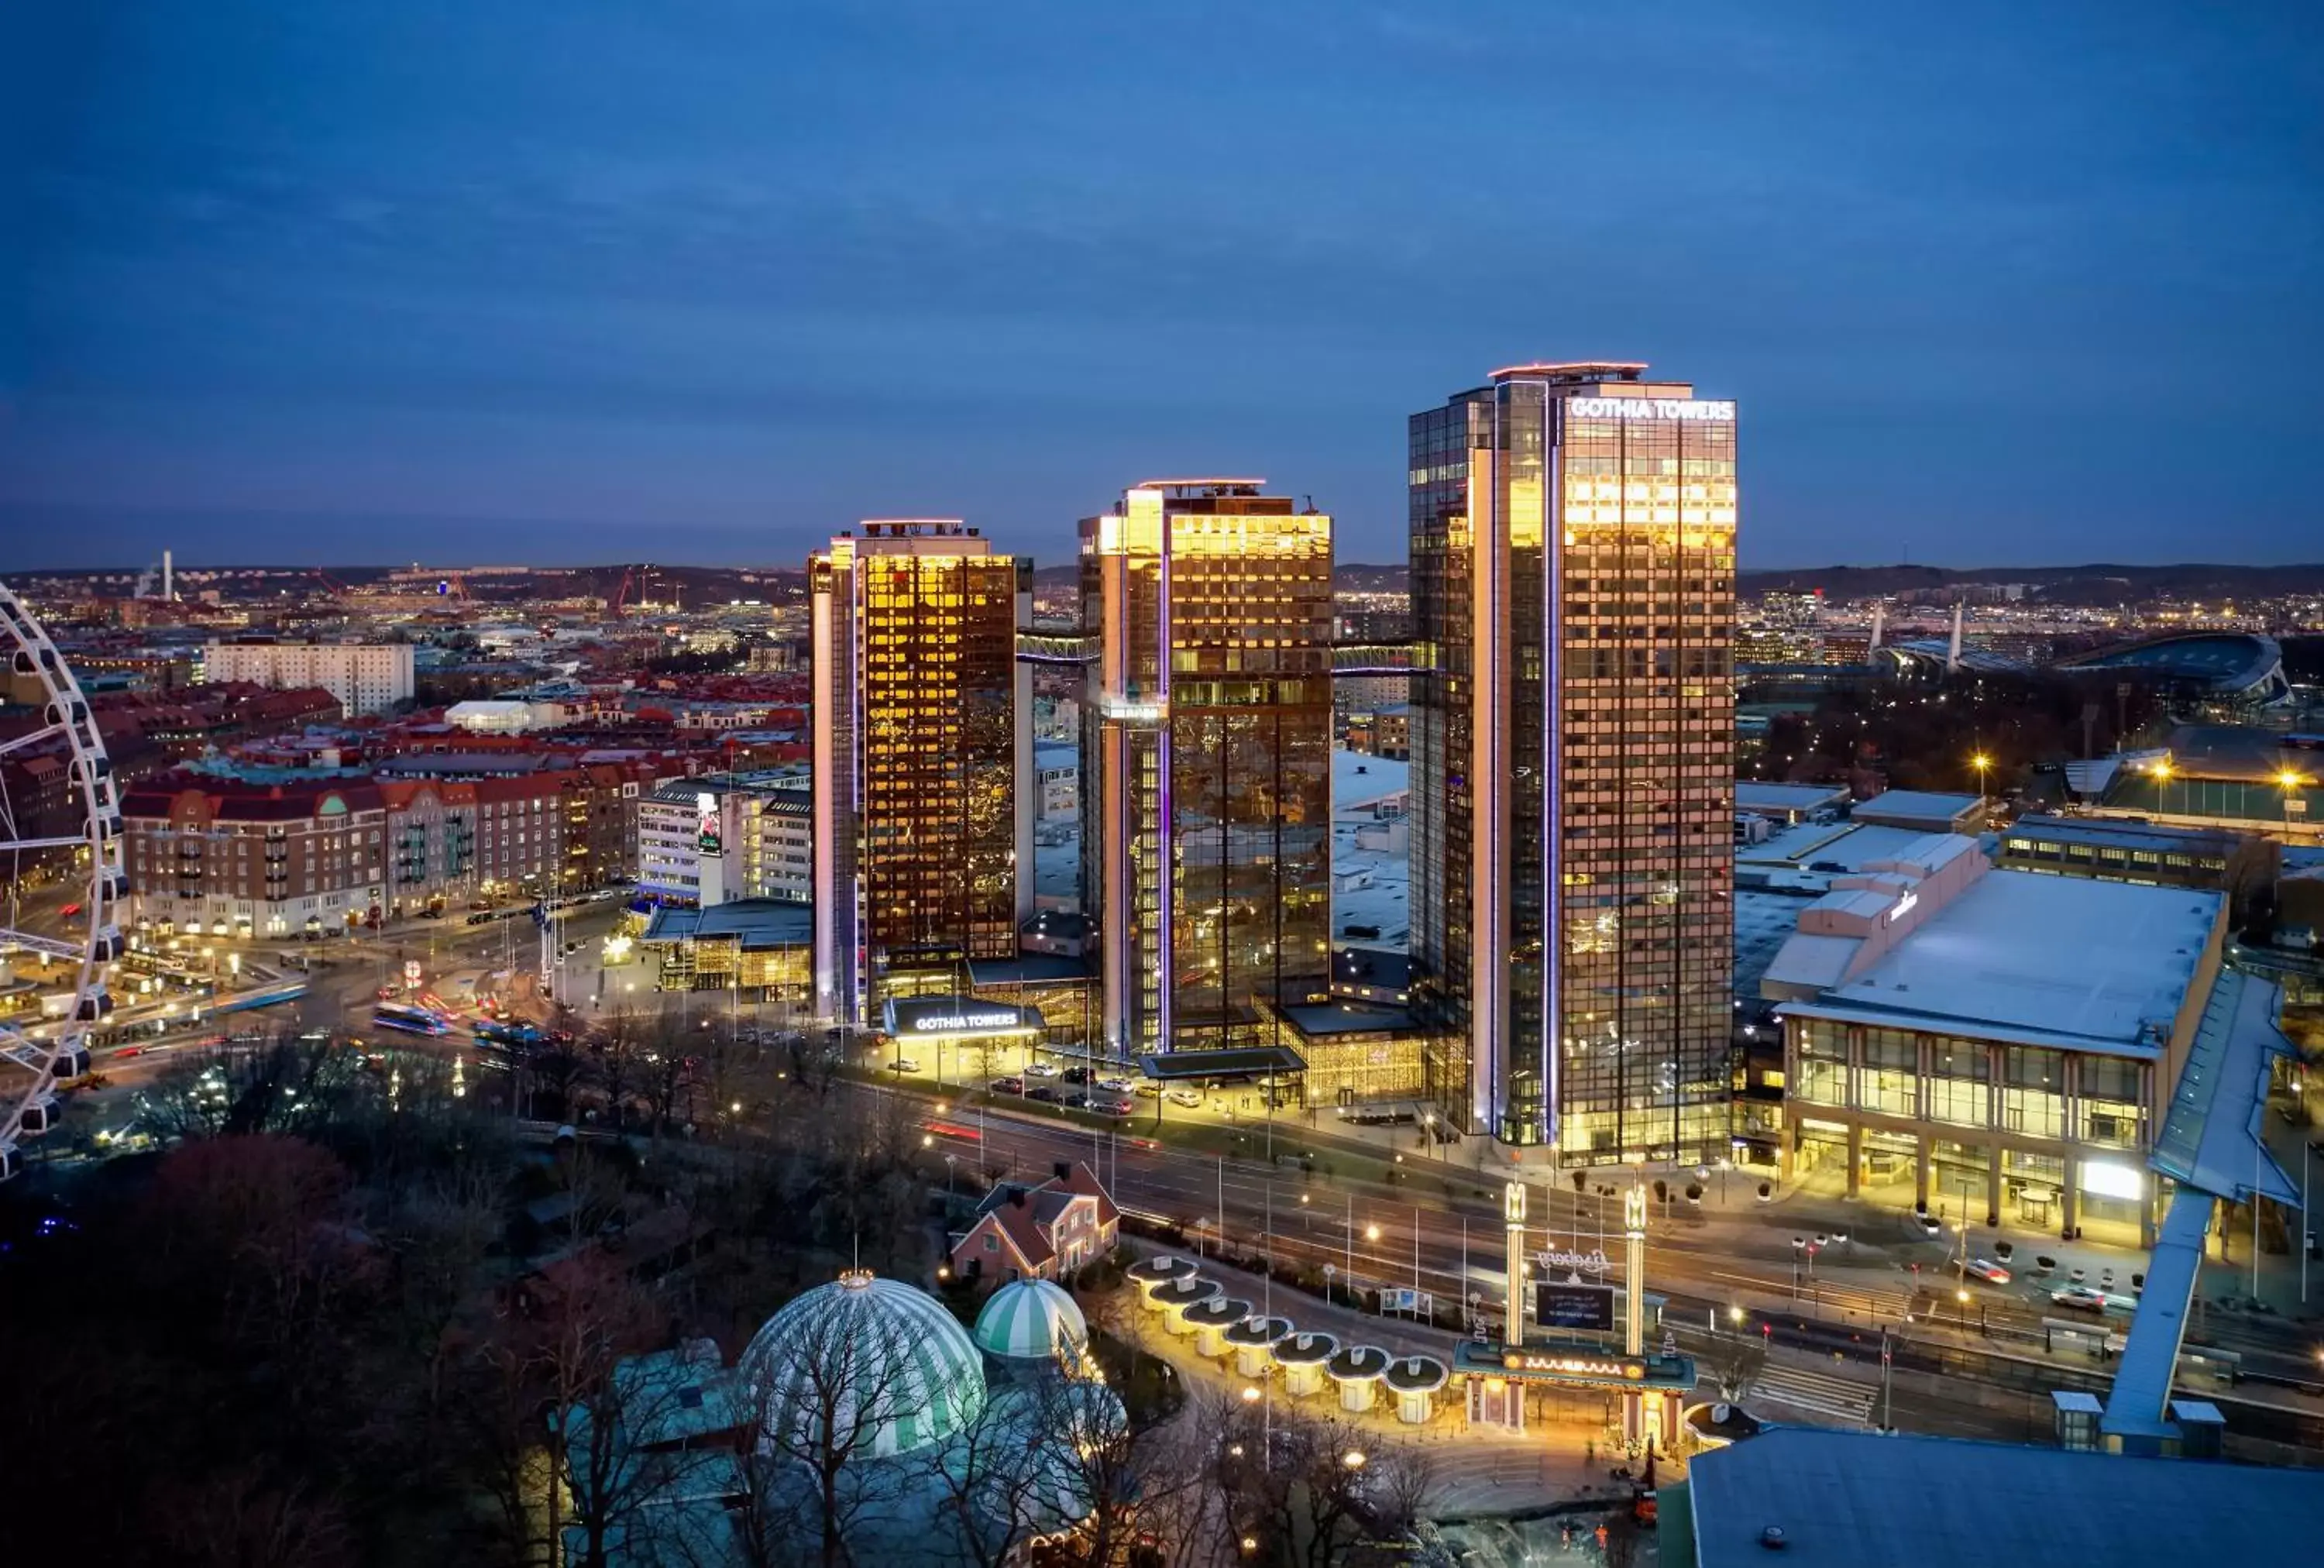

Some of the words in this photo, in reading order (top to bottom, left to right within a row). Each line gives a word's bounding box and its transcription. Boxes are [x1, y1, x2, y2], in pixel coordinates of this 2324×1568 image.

[1570, 398, 1650, 418] GOTHIA
[1655, 401, 1733, 420] TOWERS
[916, 1016, 966, 1030] GOTHIA
[968, 1013, 1017, 1026] TOWERS
